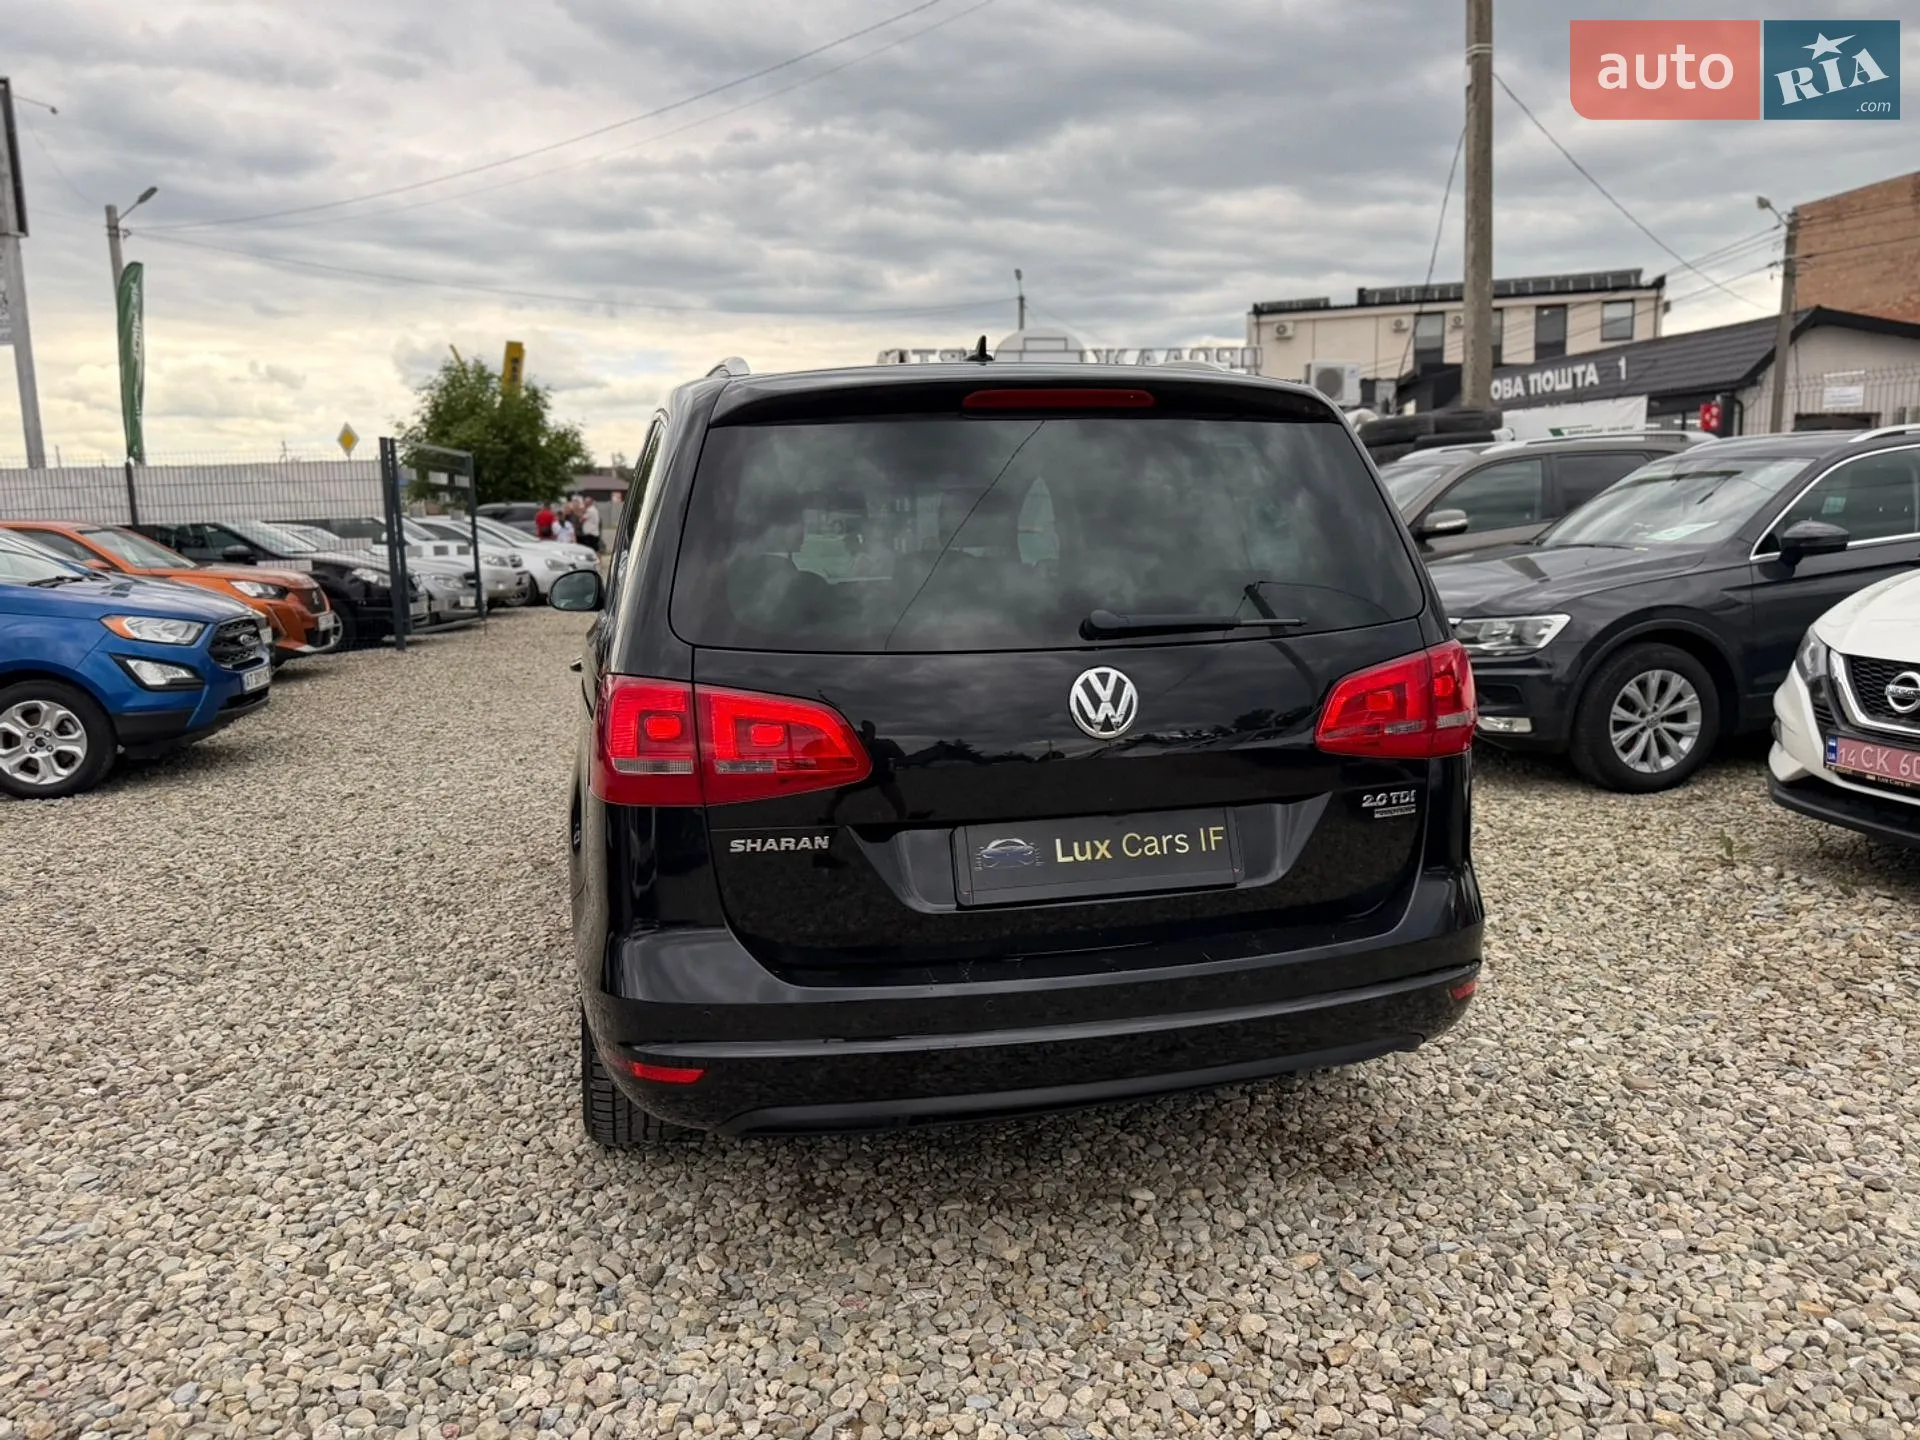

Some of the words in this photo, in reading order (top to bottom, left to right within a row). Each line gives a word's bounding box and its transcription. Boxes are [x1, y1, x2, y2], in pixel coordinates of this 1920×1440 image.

[1490, 375, 1525, 400] ОВА
[1528, 362, 1599, 395] ПОШТА
[1618, 355, 1627, 380] 1
[729, 835, 830, 853] SHARAN
[1055, 838, 1113, 863] Lux
[1122, 831, 1190, 858] Cars
[1199, 826, 1224, 851] IF
